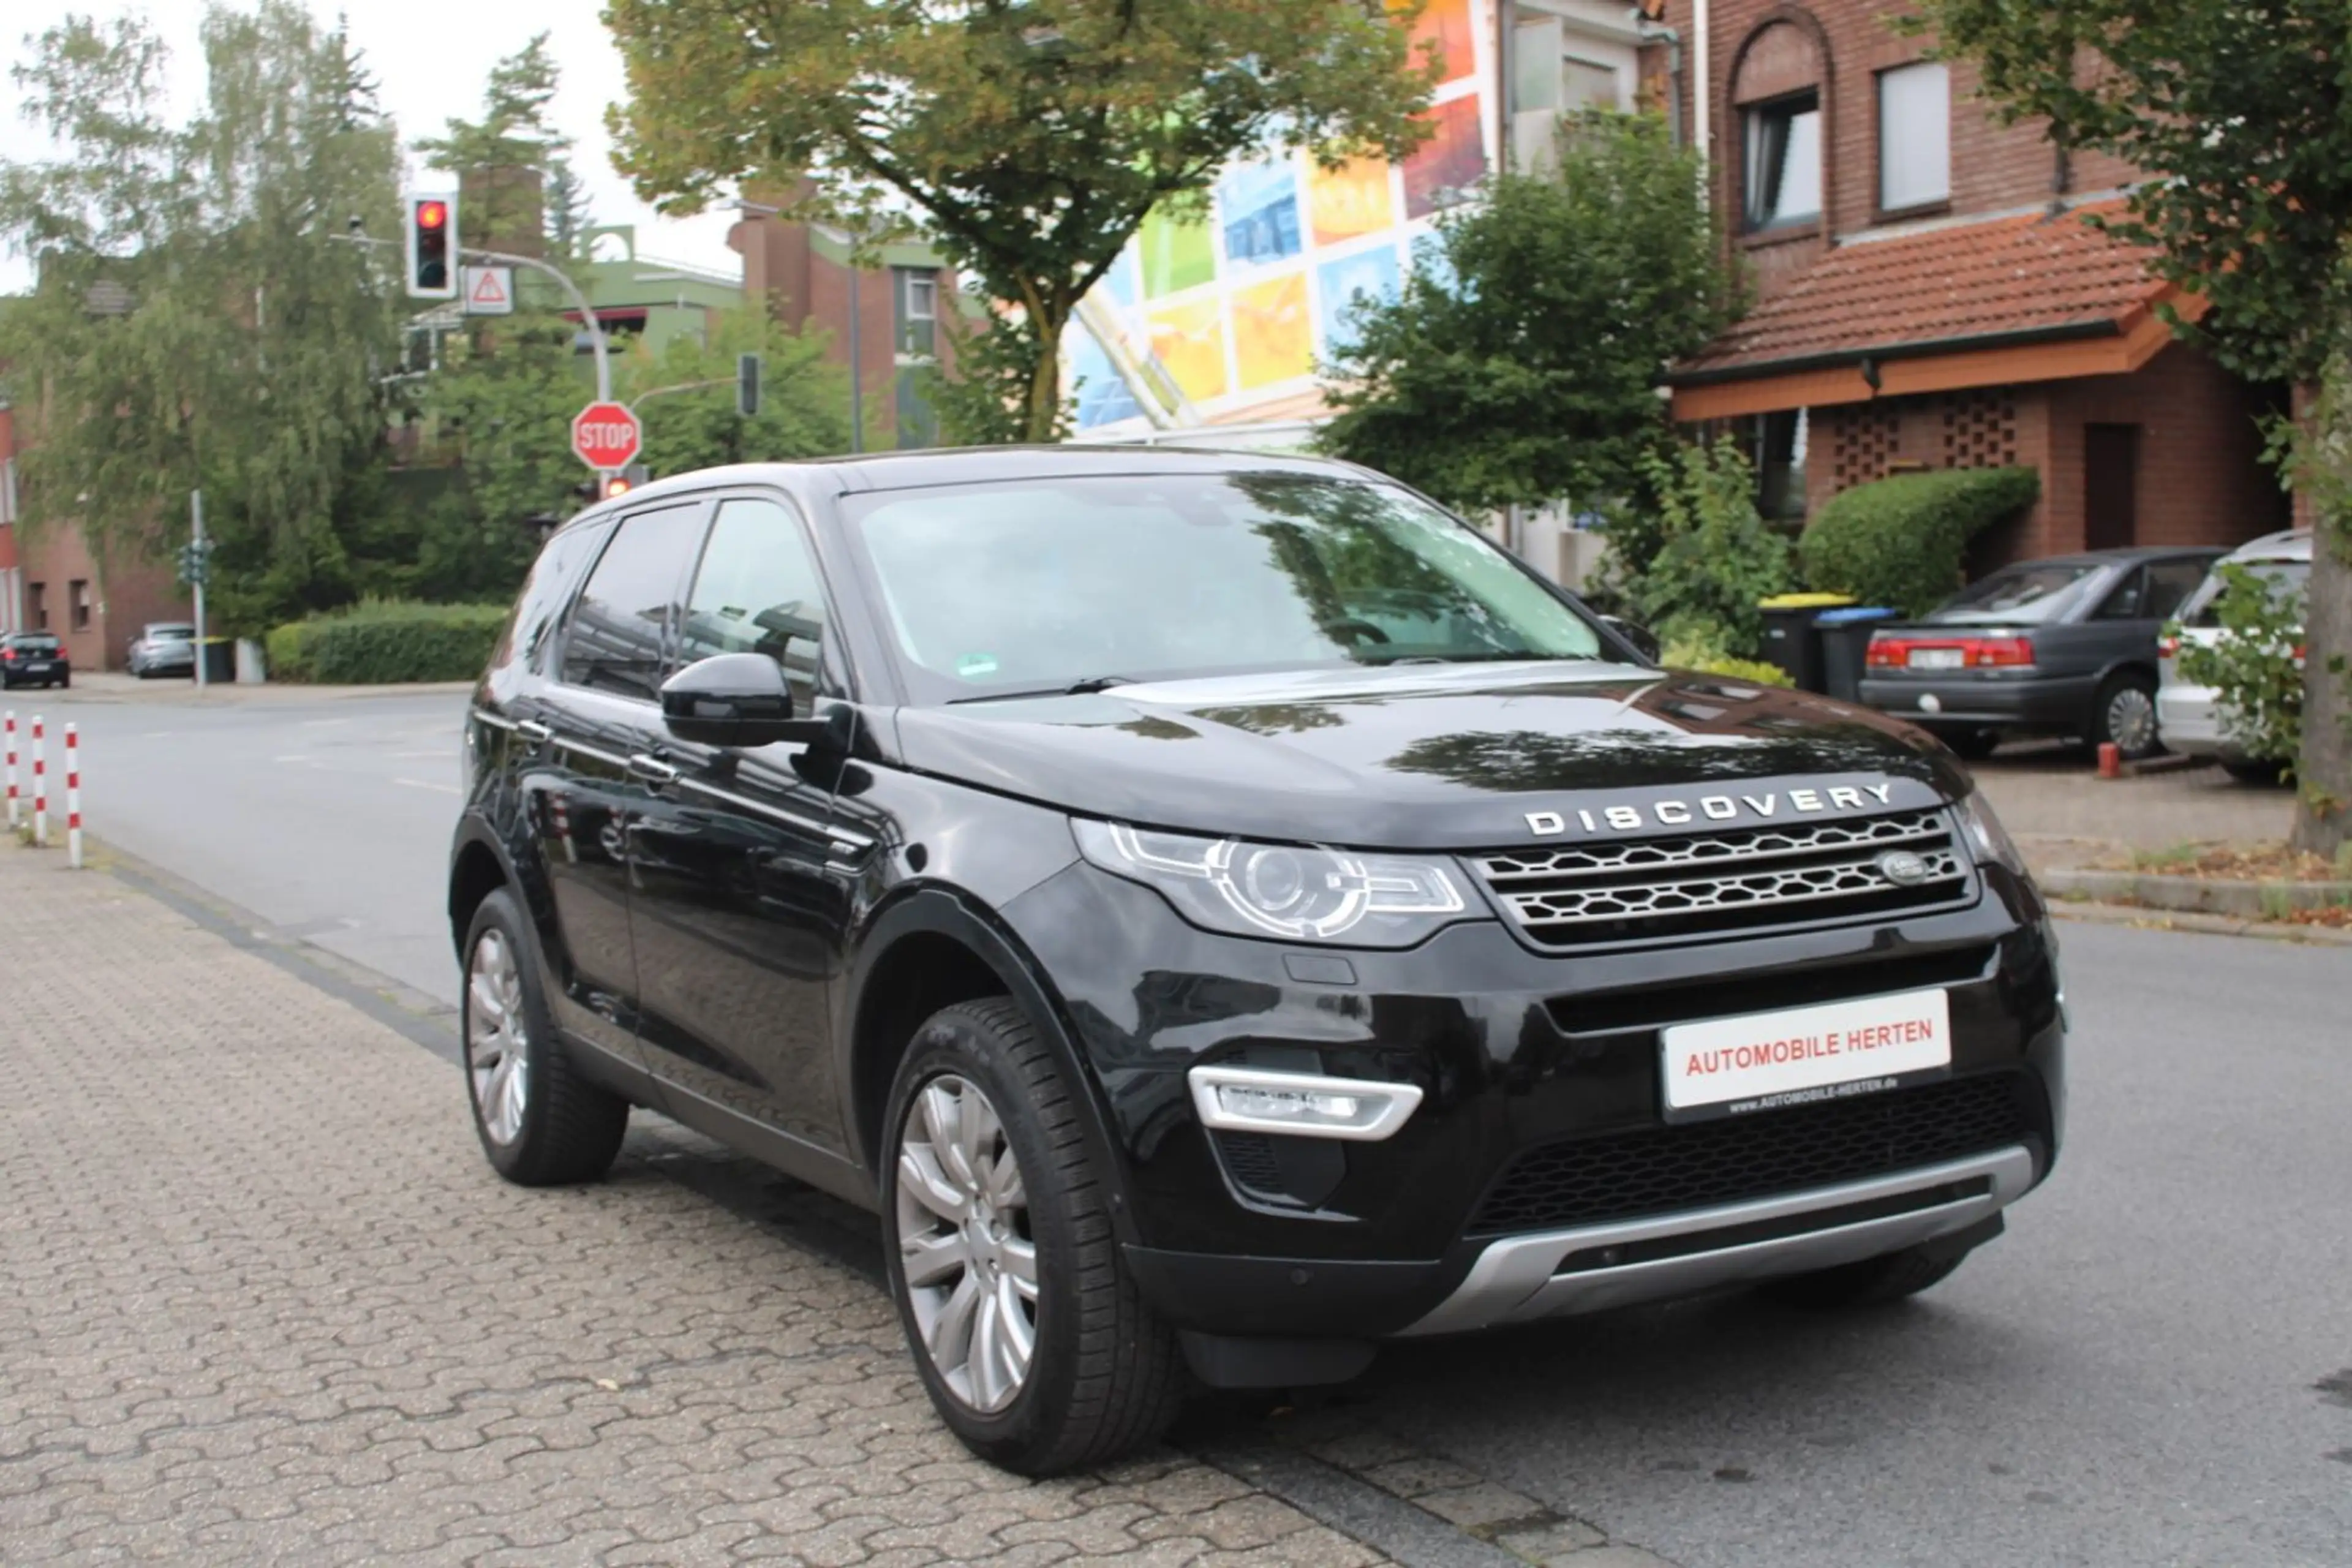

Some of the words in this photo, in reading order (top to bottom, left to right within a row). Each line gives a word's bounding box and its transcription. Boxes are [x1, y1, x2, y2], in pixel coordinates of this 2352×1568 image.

[581, 423, 634, 449] STOP
[1525, 784, 1890, 835] DISCOVERY
[1686, 1033, 1839, 1076] AUTOMOBILE
[1848, 1020, 1932, 1051] HERTEN
